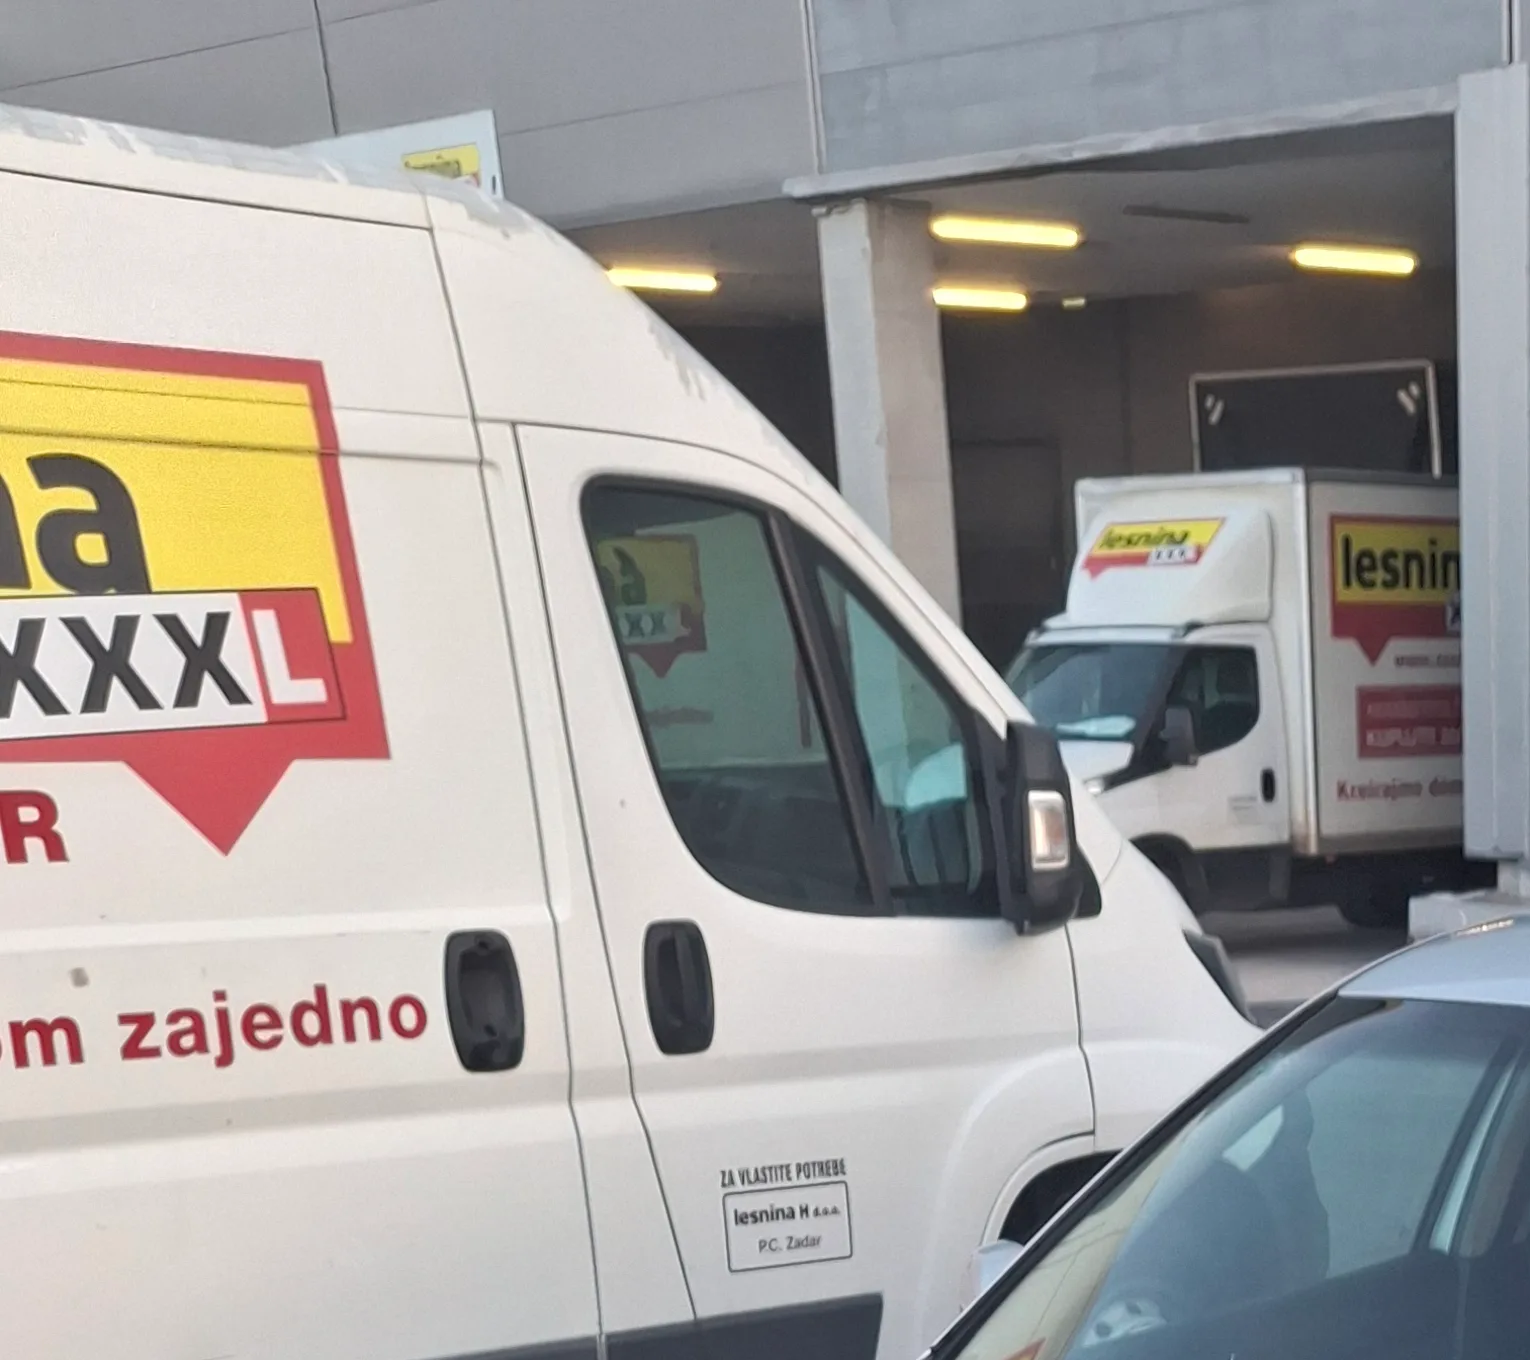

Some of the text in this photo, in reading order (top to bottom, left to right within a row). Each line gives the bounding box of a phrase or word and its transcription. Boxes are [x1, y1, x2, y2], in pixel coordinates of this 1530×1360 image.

[0, 983, 428, 1069] m zajedno
[720, 1158, 846, 1188] ZA VLASTITE POTREBE
[734, 1203, 795, 1226] lesnina
[786, 1234, 822, 1251] Zadar
